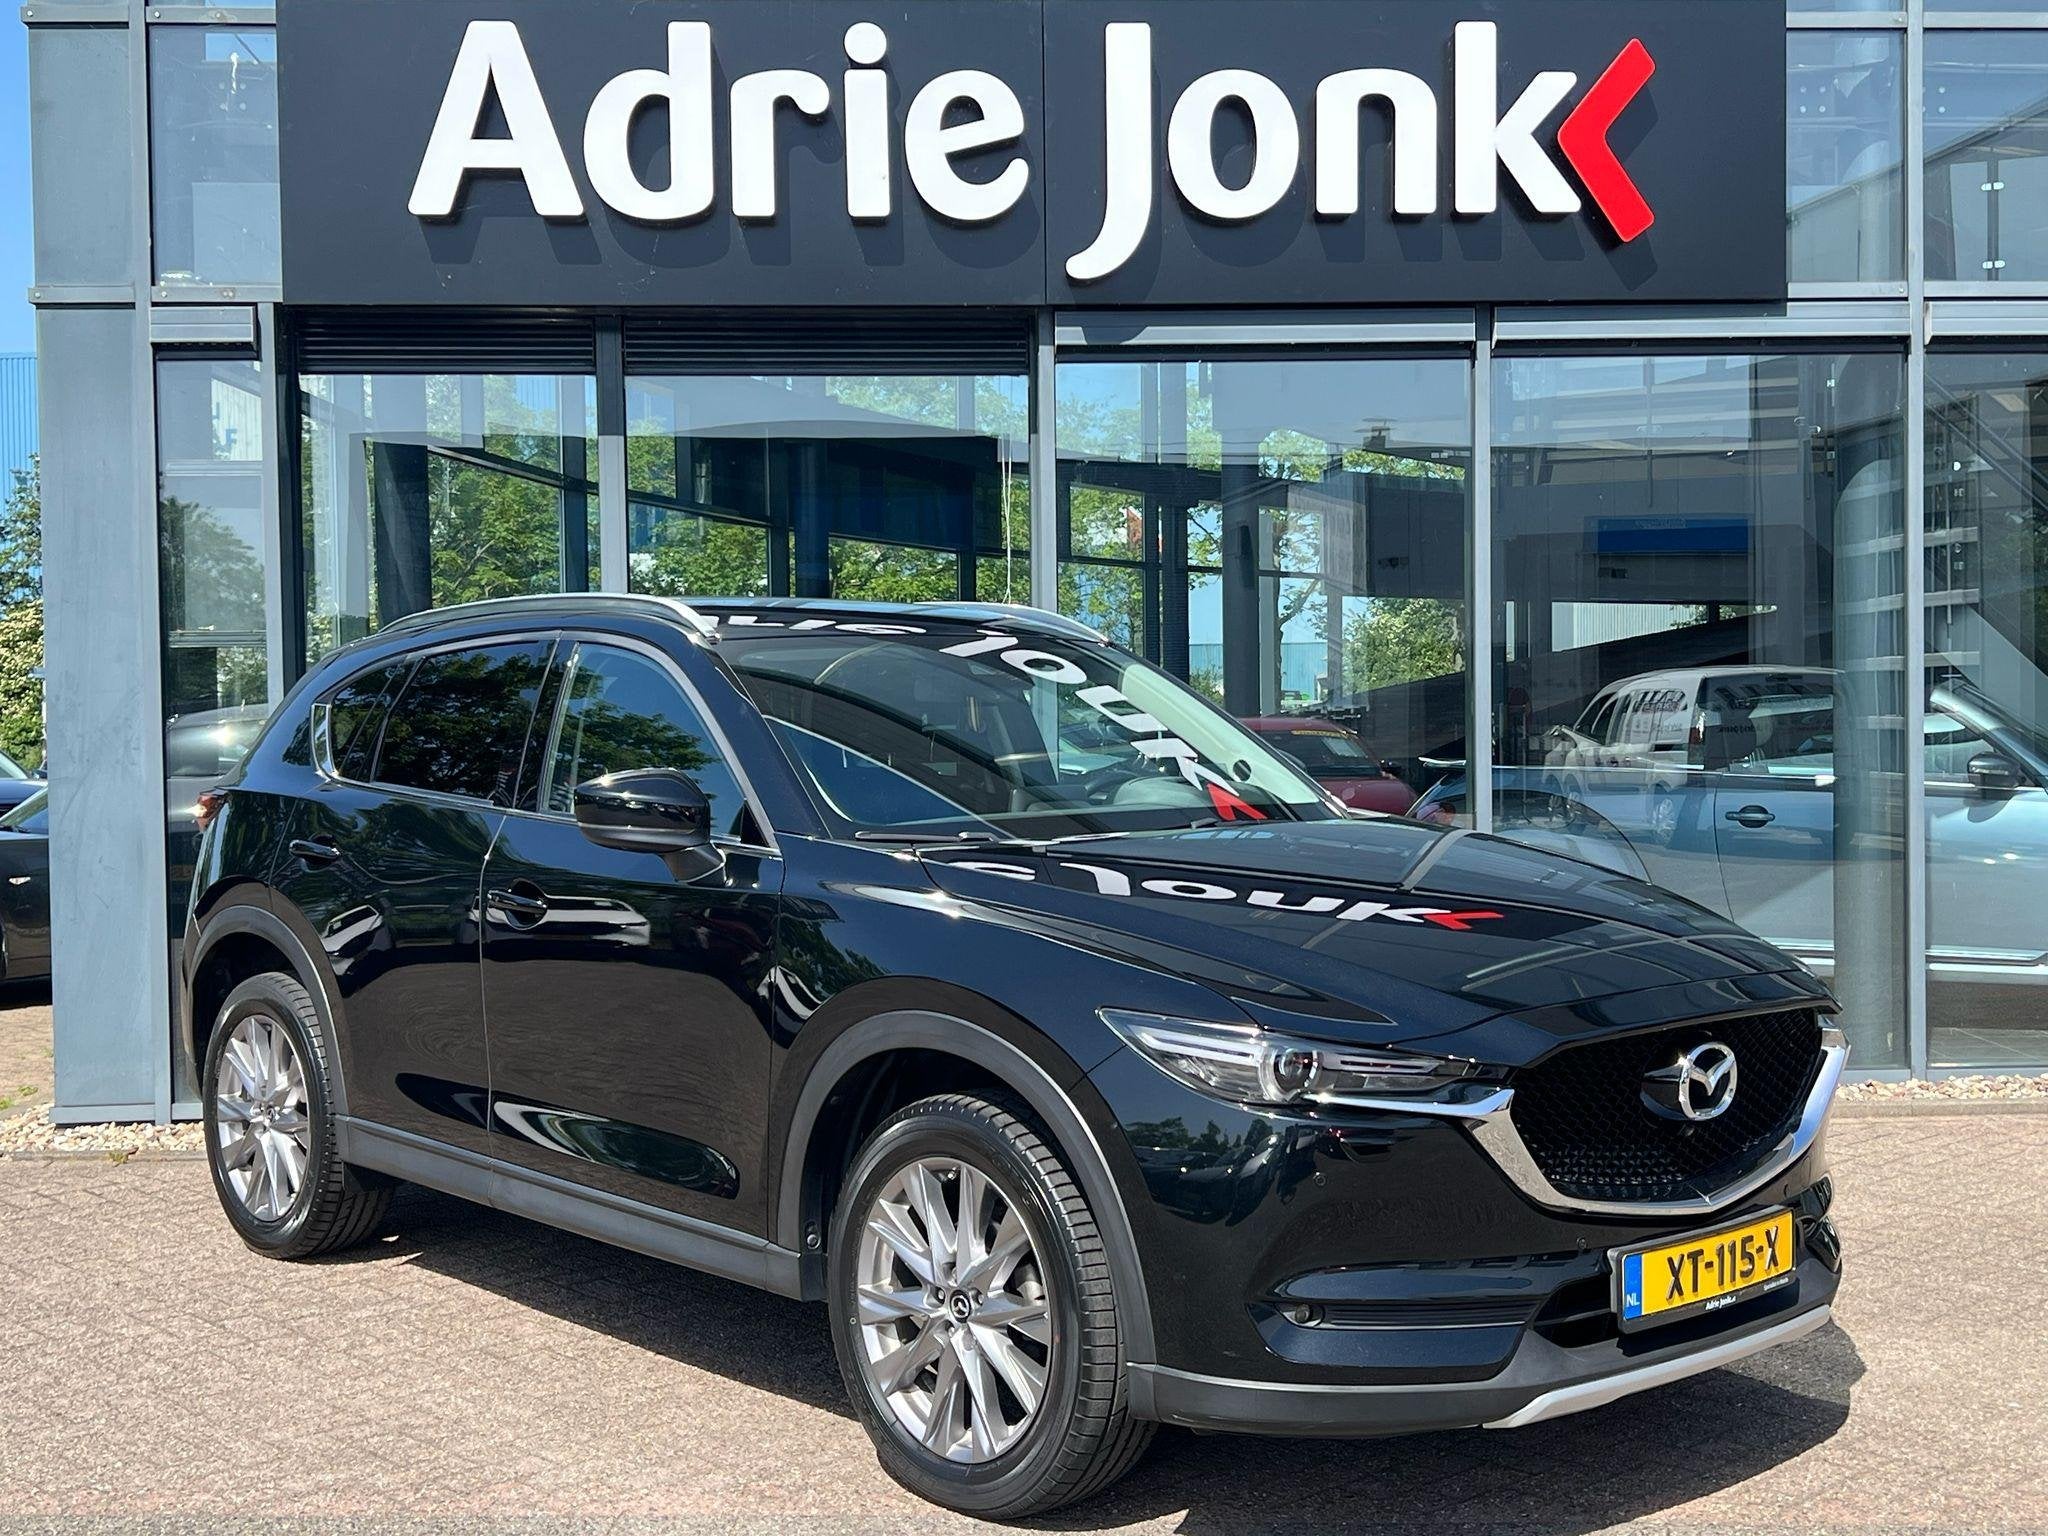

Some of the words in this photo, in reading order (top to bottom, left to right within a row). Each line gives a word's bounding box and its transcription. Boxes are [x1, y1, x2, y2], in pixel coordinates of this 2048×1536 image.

[407, 20, 1030, 221] Adrie
[1065, 20, 1582, 280] Jonk
[1626, 1292, 1641, 1308] NL
[1666, 1225, 1779, 1301] XT-115-X
